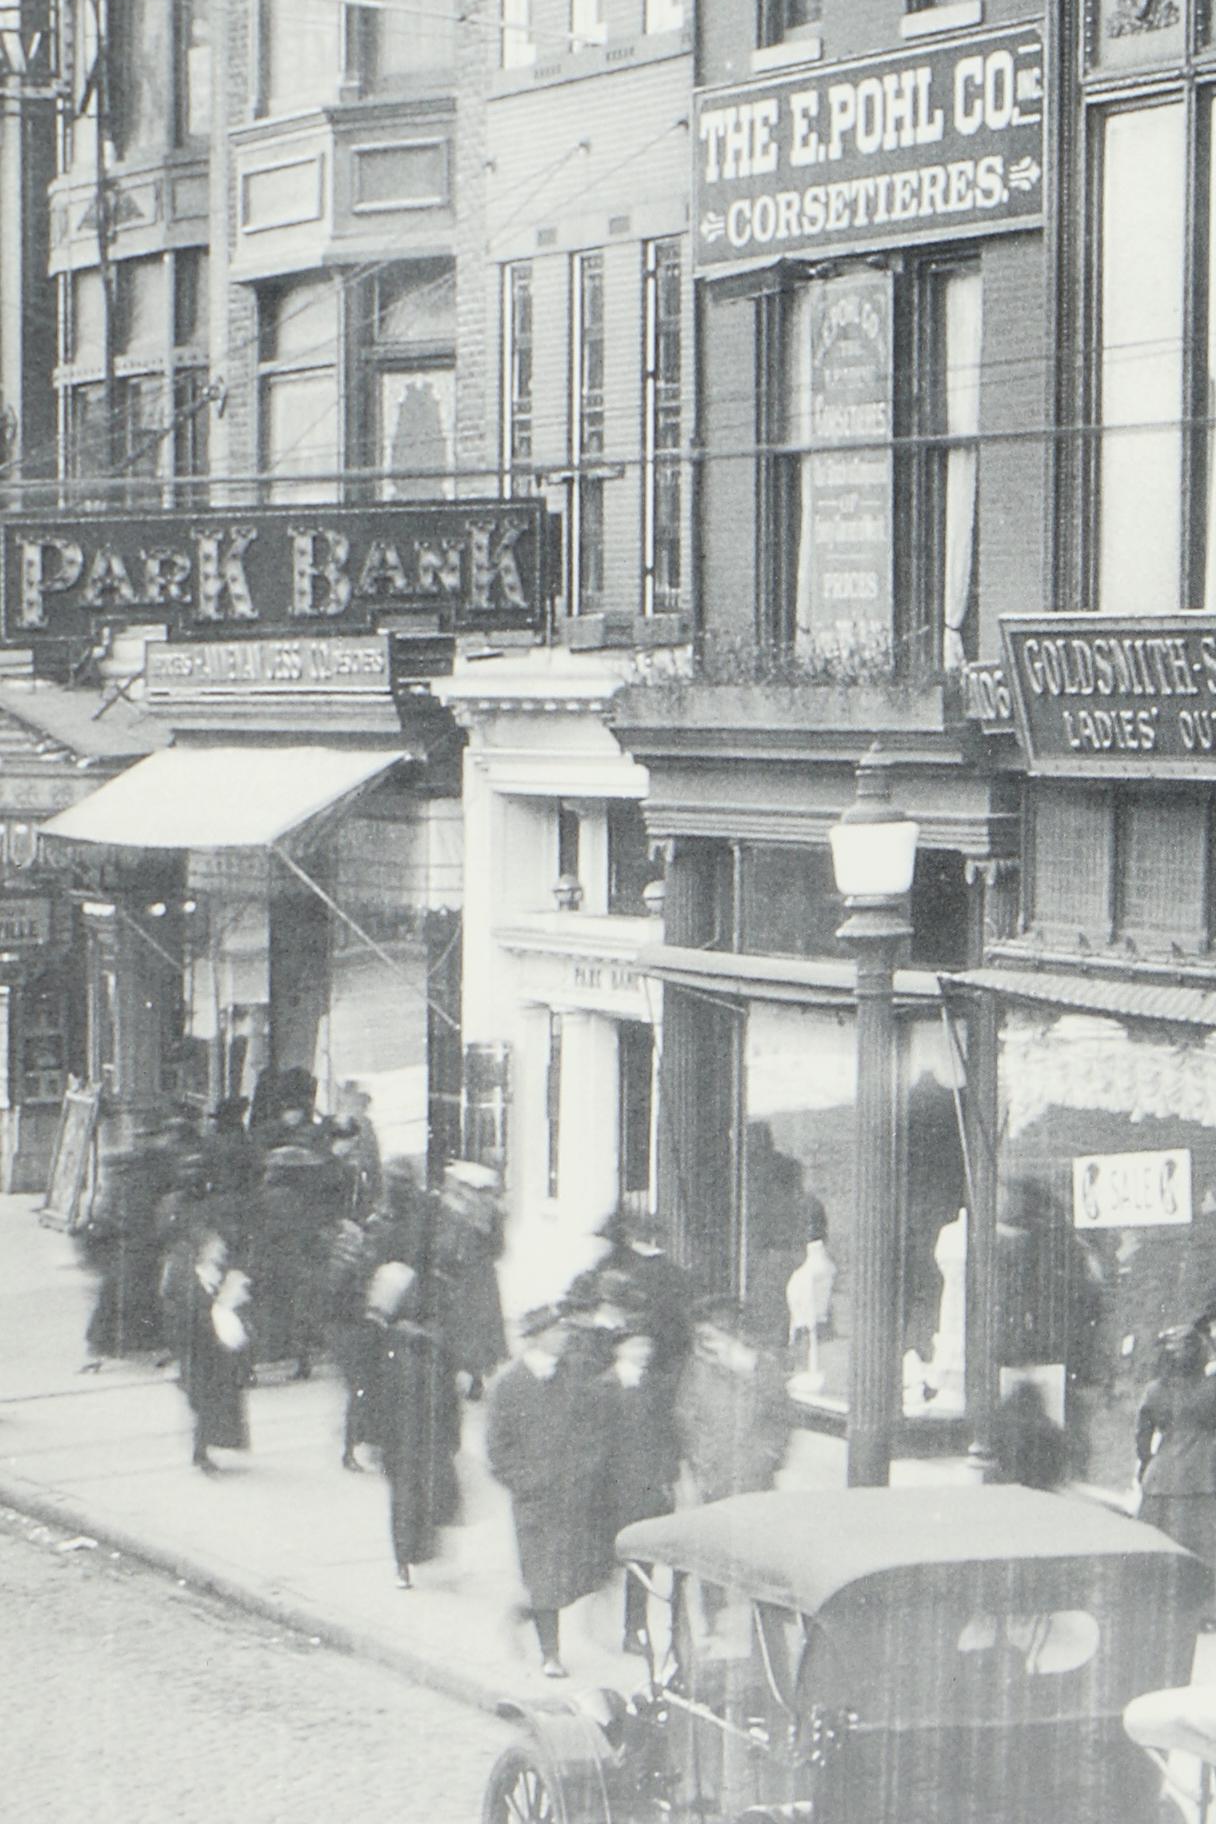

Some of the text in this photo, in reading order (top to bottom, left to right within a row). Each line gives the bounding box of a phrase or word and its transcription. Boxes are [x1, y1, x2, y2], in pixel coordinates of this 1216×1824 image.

[701, 98, 778, 183] THE
[15, 517, 530, 628] PARK BANK
